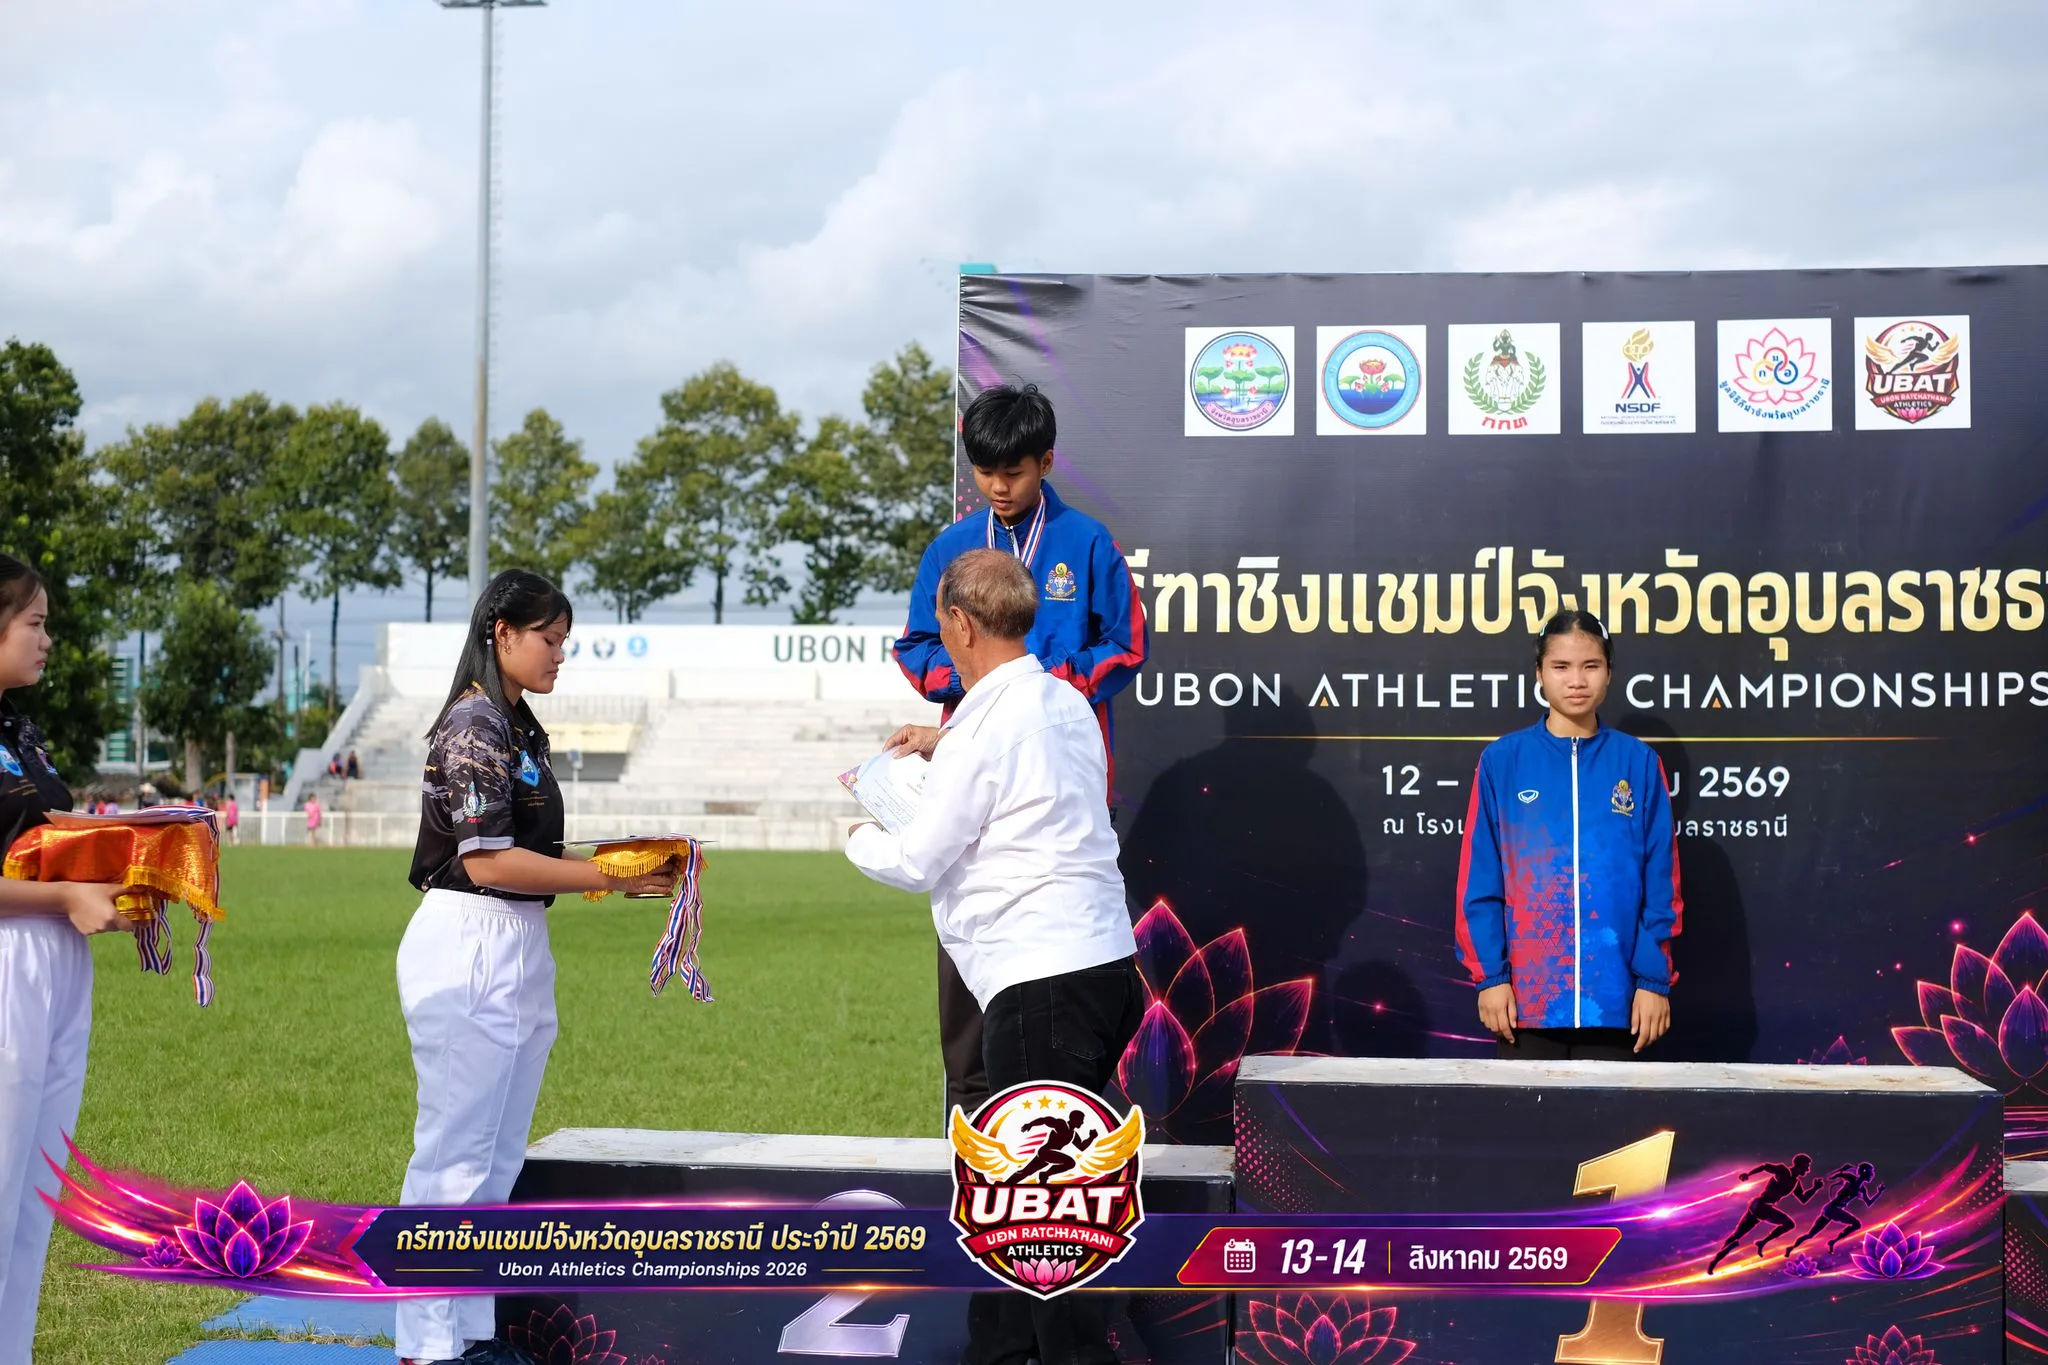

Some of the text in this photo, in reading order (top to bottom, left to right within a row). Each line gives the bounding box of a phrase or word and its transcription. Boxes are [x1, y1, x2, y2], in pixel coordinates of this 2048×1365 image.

[1873, 373, 1952, 394] UBAT
[1615, 403, 1661, 413] NSDF
[773, 634, 865, 662] UBON
[1135, 672, 1281, 707] UBON
[1626, 671, 2048, 708] CHAMPIONSHIPS
[1382, 765, 1420, 795] 12
[1699, 766, 1790, 797] 2569
[1383, 818, 1404, 835] ณ
[1416, 812, 1464, 835] โรงเ
